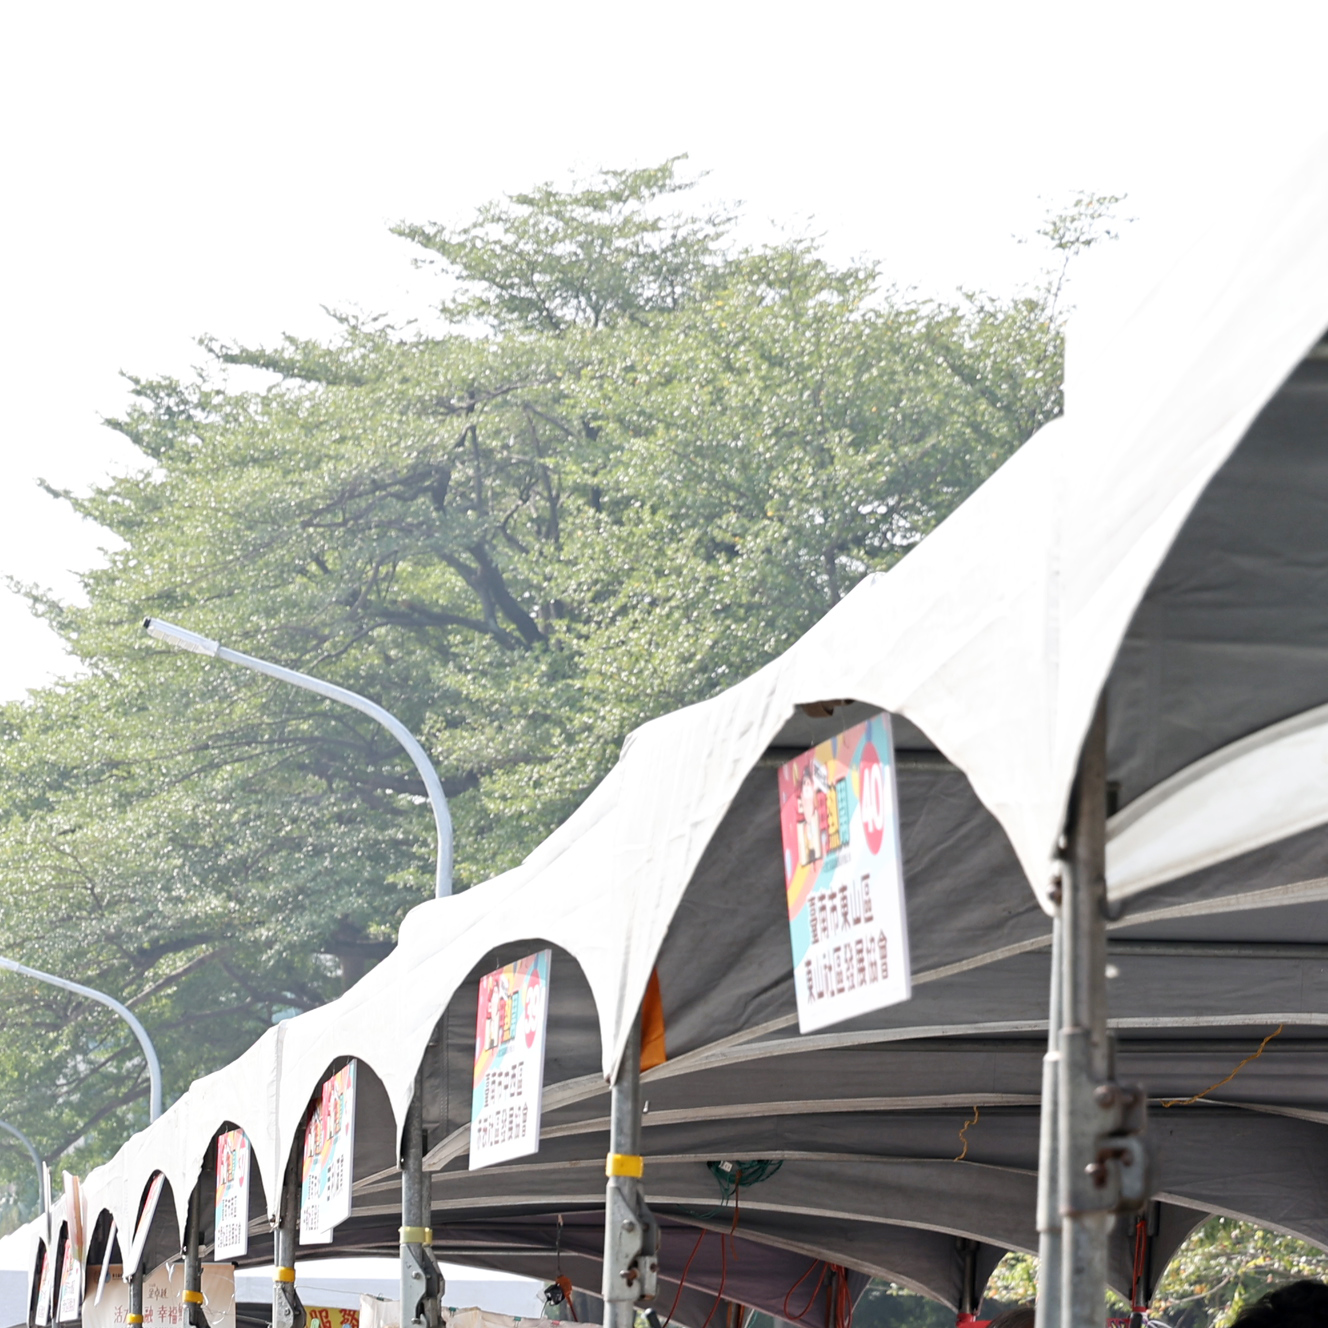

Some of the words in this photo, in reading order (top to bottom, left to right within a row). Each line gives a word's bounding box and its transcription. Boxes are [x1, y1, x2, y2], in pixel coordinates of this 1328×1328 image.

[862, 763, 884, 835] 40
[808, 873, 874, 946] 臺南市東山區
[804, 928, 889, 1005] 東山社區發展協會
